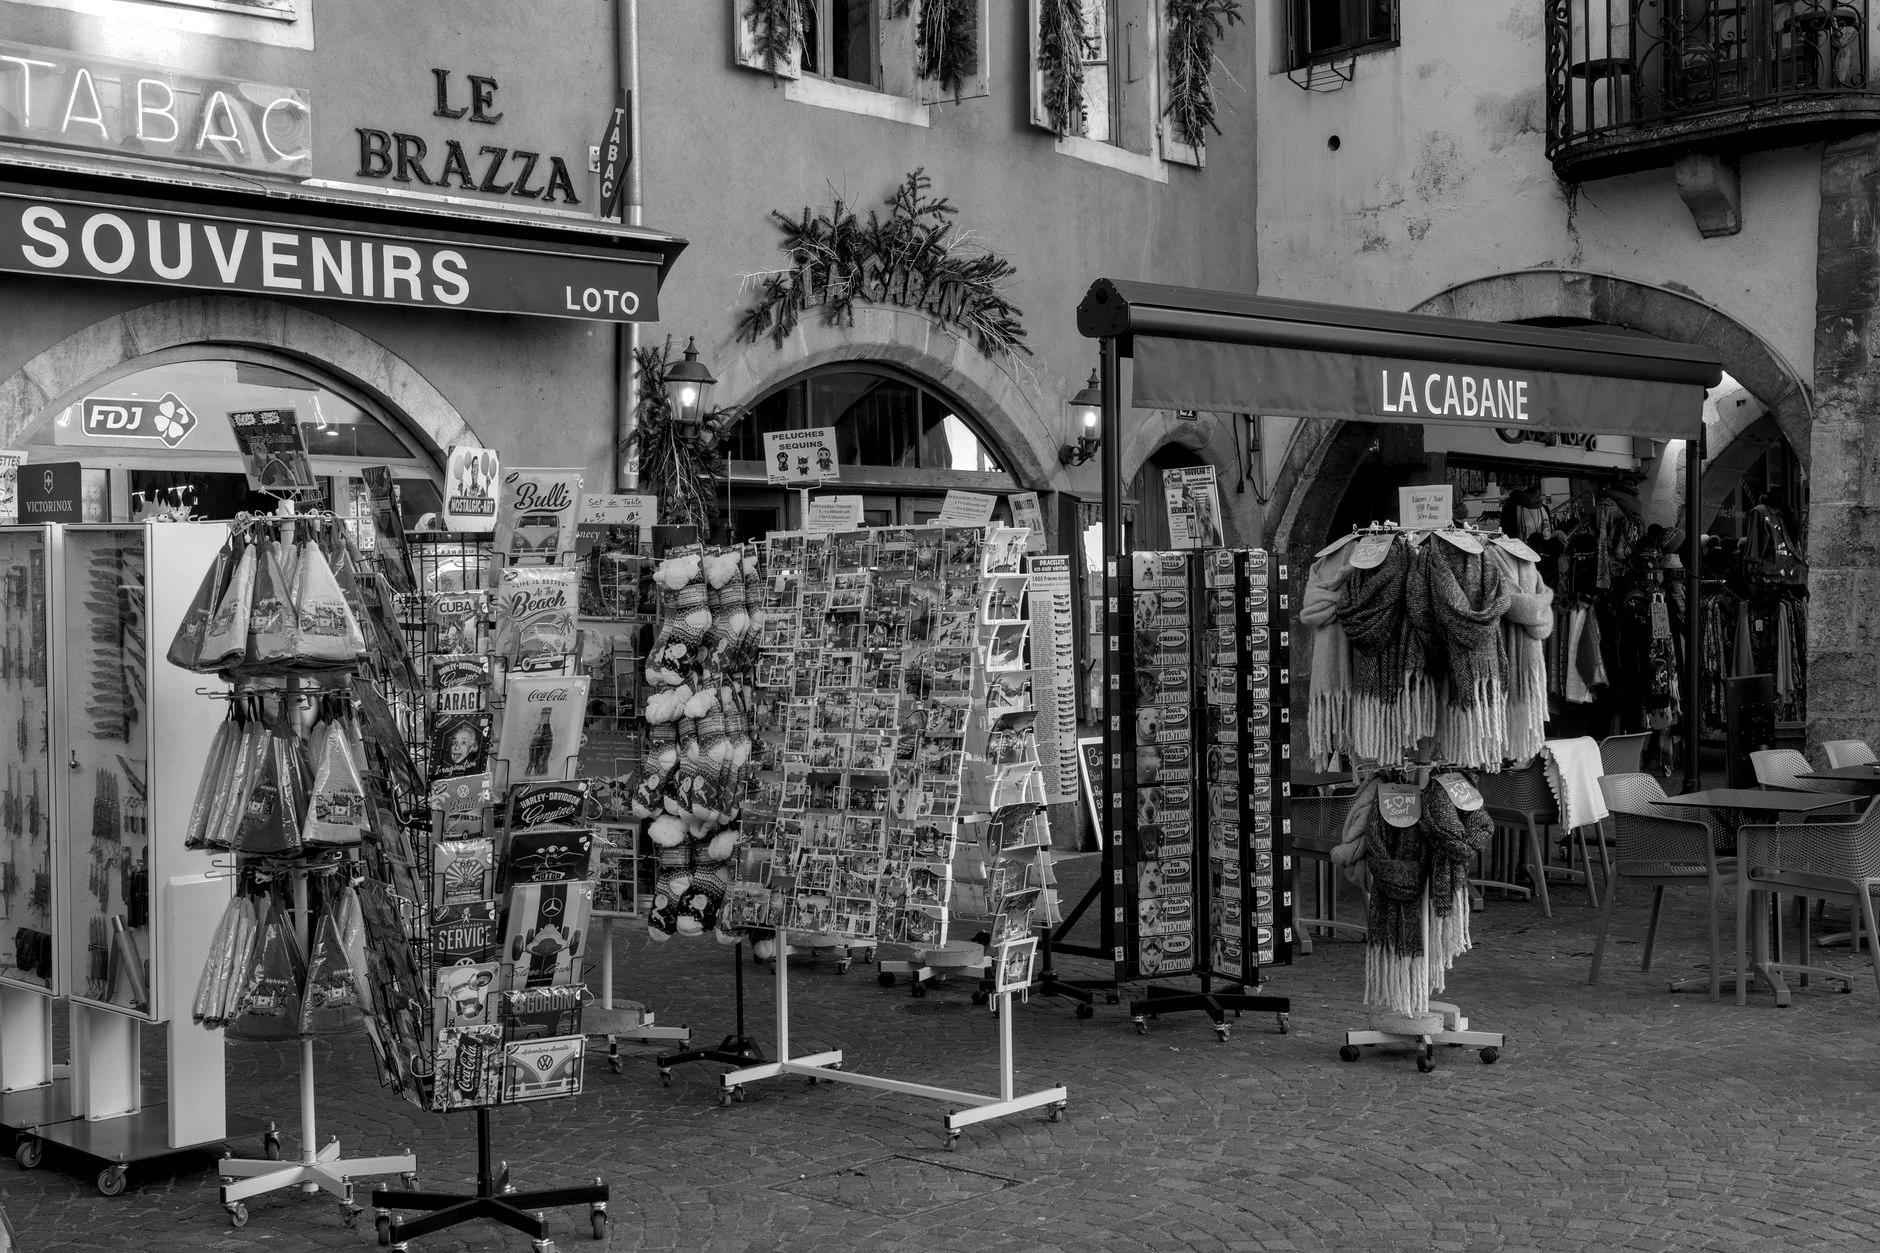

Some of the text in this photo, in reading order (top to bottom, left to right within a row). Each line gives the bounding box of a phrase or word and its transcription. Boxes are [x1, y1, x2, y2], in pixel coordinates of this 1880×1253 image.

[432, 68, 504, 125] LE
[0, 55, 309, 160] TABAC
[600, 108, 625, 200] TABAC
[355, 127, 582, 204] BRAZZA
[21, 206, 470, 305] SOUVENIRS
[565, 286, 640, 315] LOTO
[1382, 370, 1529, 420] LA CABANE
[89, 405, 143, 431] FDJ
[772, 431, 825, 441] PELUCHES
[779, 441, 823, 451] SEQUINS
[514, 482, 572, 511] Bulli
[26, 500, 73, 513] VICTORINOX
[450, 499, 494, 514] NOSTALGIC-ART
[542, 579, 565, 587] BETTER
[1152, 575, 1187, 588] ATTENTION
[533, 586, 556, 597] At The
[439, 601, 473, 613] CUBA
[511, 589, 567, 618] Beach
[1153, 614, 1188, 627] ATTENTION
[1152, 653, 1189, 666] ATTENTION
[1154, 691, 1189, 704] ATTENTION
[1155, 729, 1190, 742] ATTENTION
[434, 761, 478, 776] Imagination
[1155, 769, 1190, 781] ATTENTION
[519, 791, 582, 809] HARLEY-DAVIDSON
[521, 804, 576, 833] Genuine
[1157, 809, 1191, 822] ATTENTION
[1157, 843, 1192, 858] ATTENTION
[533, 871, 564, 881] MOTOR
[1157, 882, 1191, 896] ATTENTION
[1158, 919, 1192, 932] ATTENTION
[438, 925, 493, 951] SERVICE
[1159, 957, 1193, 972] ATTENTION
[521, 1048, 550, 1057] Adventure
